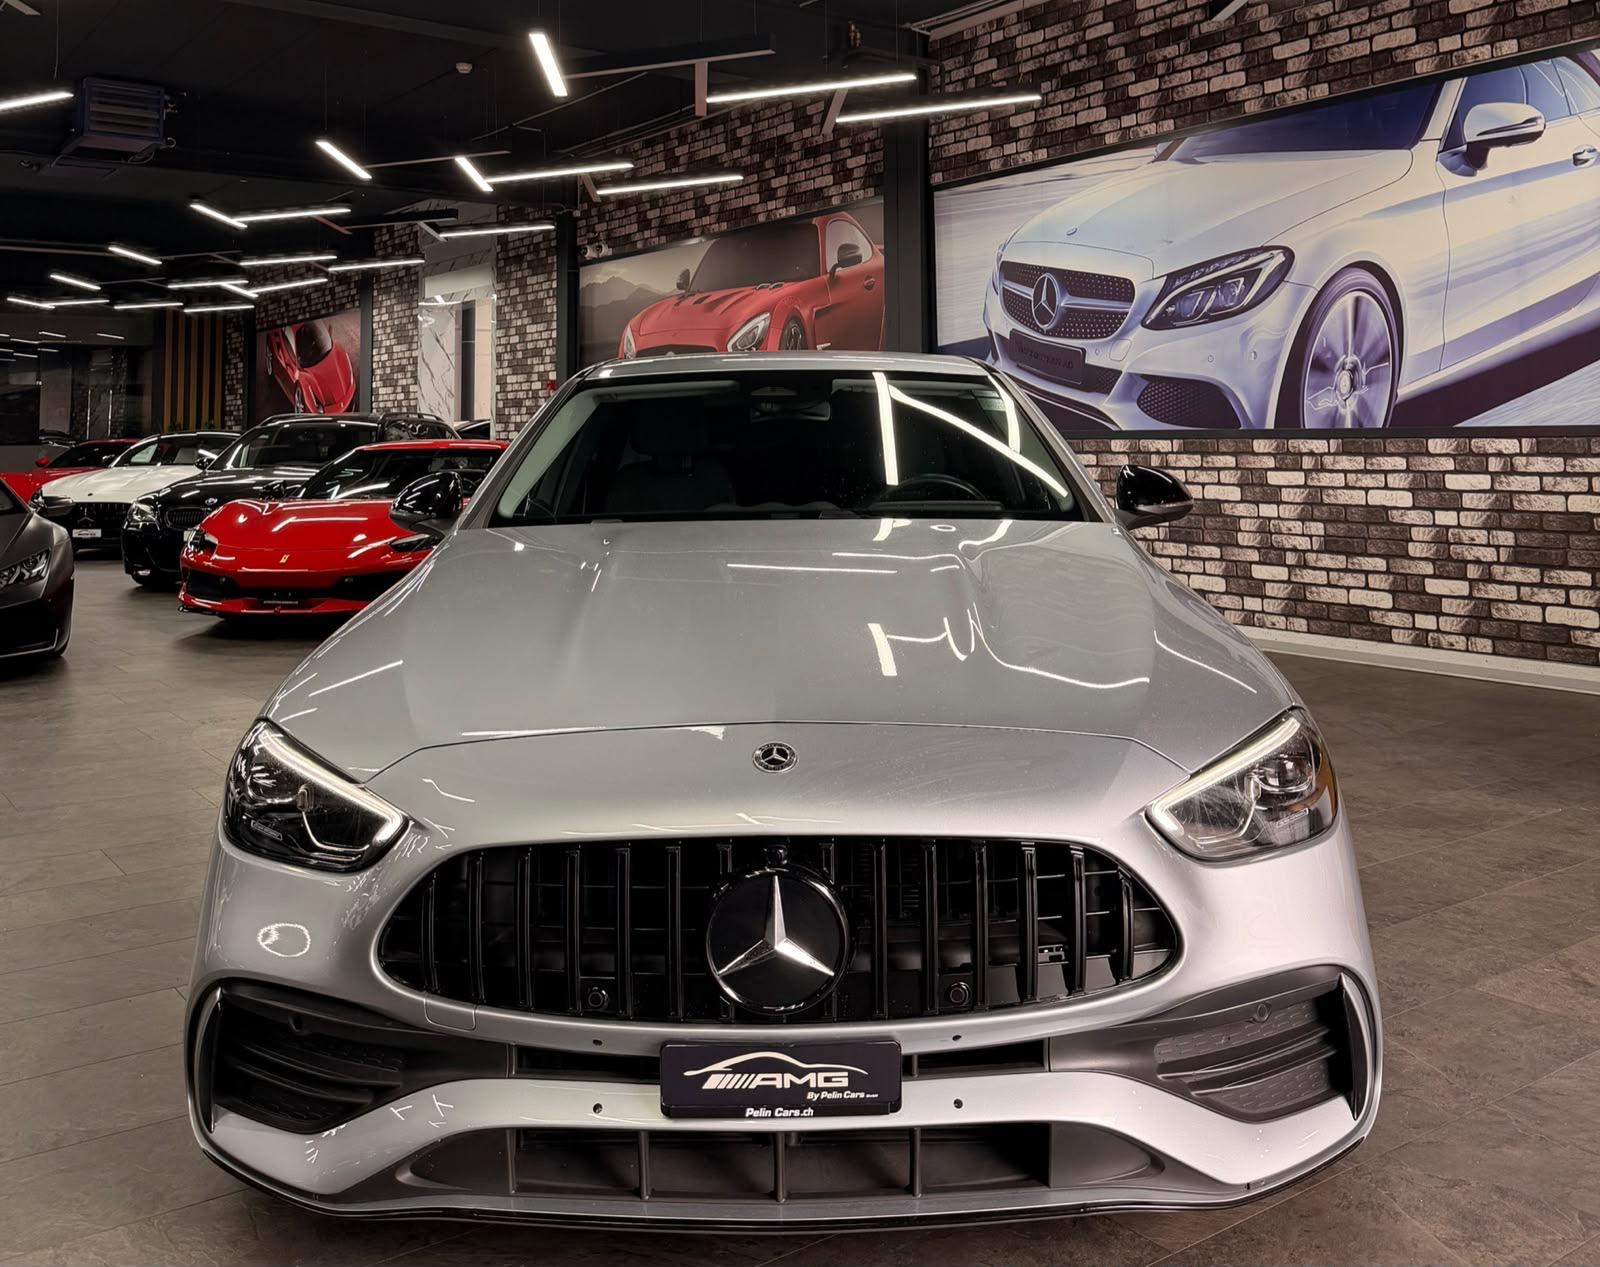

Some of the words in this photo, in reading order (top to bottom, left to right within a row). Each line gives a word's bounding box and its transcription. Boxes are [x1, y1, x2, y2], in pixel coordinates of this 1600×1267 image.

[748, 1071, 849, 1088] AMG
[806, 1091, 820, 1101] By
[820, 1091, 843, 1099] Pelin
[843, 1090, 866, 1099] Cars
[745, 1107, 772, 1117] Pelin
[774, 1107, 814, 1117] Cars.ch
